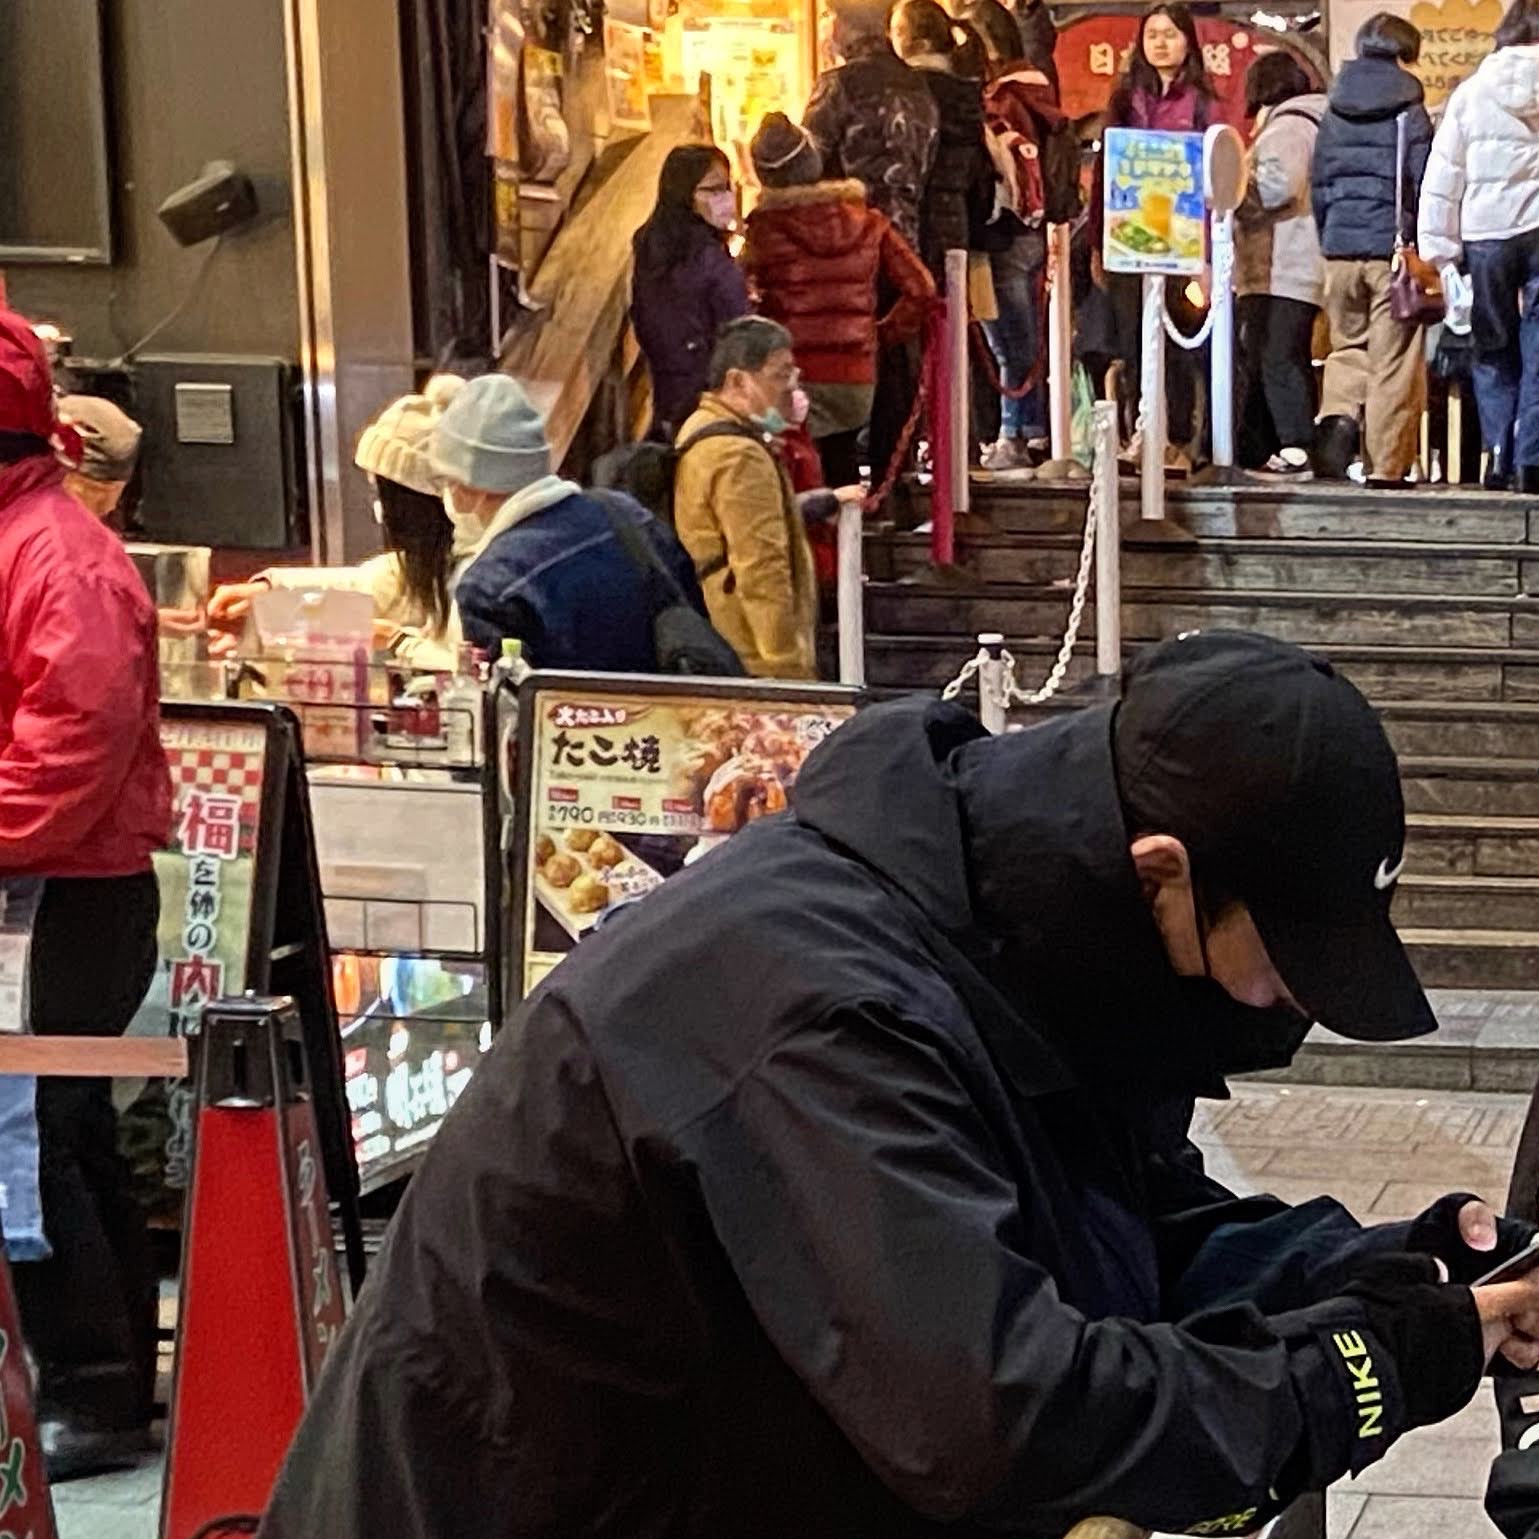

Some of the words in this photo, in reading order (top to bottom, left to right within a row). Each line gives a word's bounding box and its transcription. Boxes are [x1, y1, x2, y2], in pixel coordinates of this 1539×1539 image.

[551, 731, 661, 773] たこ焼
[1333, 1329, 1384, 1439] NIKE
